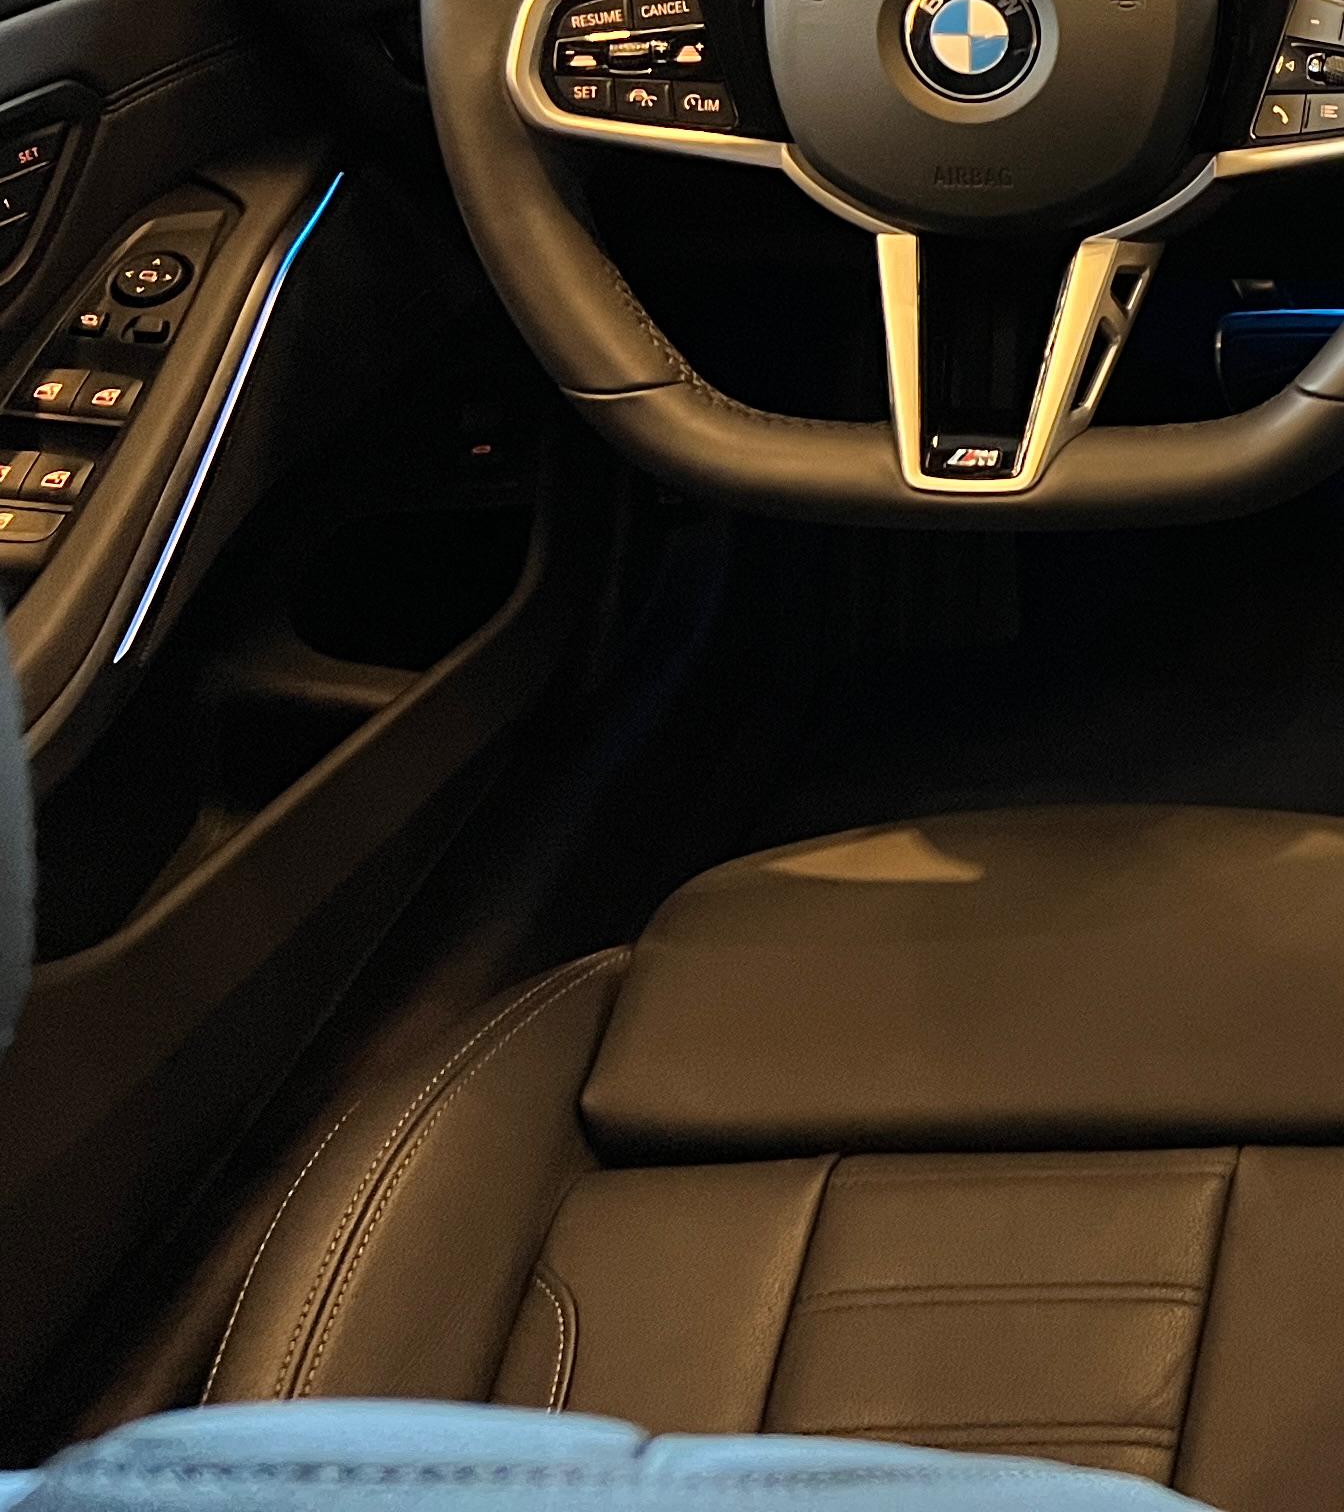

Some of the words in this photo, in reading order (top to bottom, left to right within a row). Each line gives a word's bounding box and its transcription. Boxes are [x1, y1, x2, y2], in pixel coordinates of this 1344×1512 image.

[641, 0, 690, 18] CANCEL
[571, 9, 623, 28] RESUME
[574, 86, 598, 100] SET
[697, 99, 720, 112] LIM
[18, 147, 39, 164] SET
